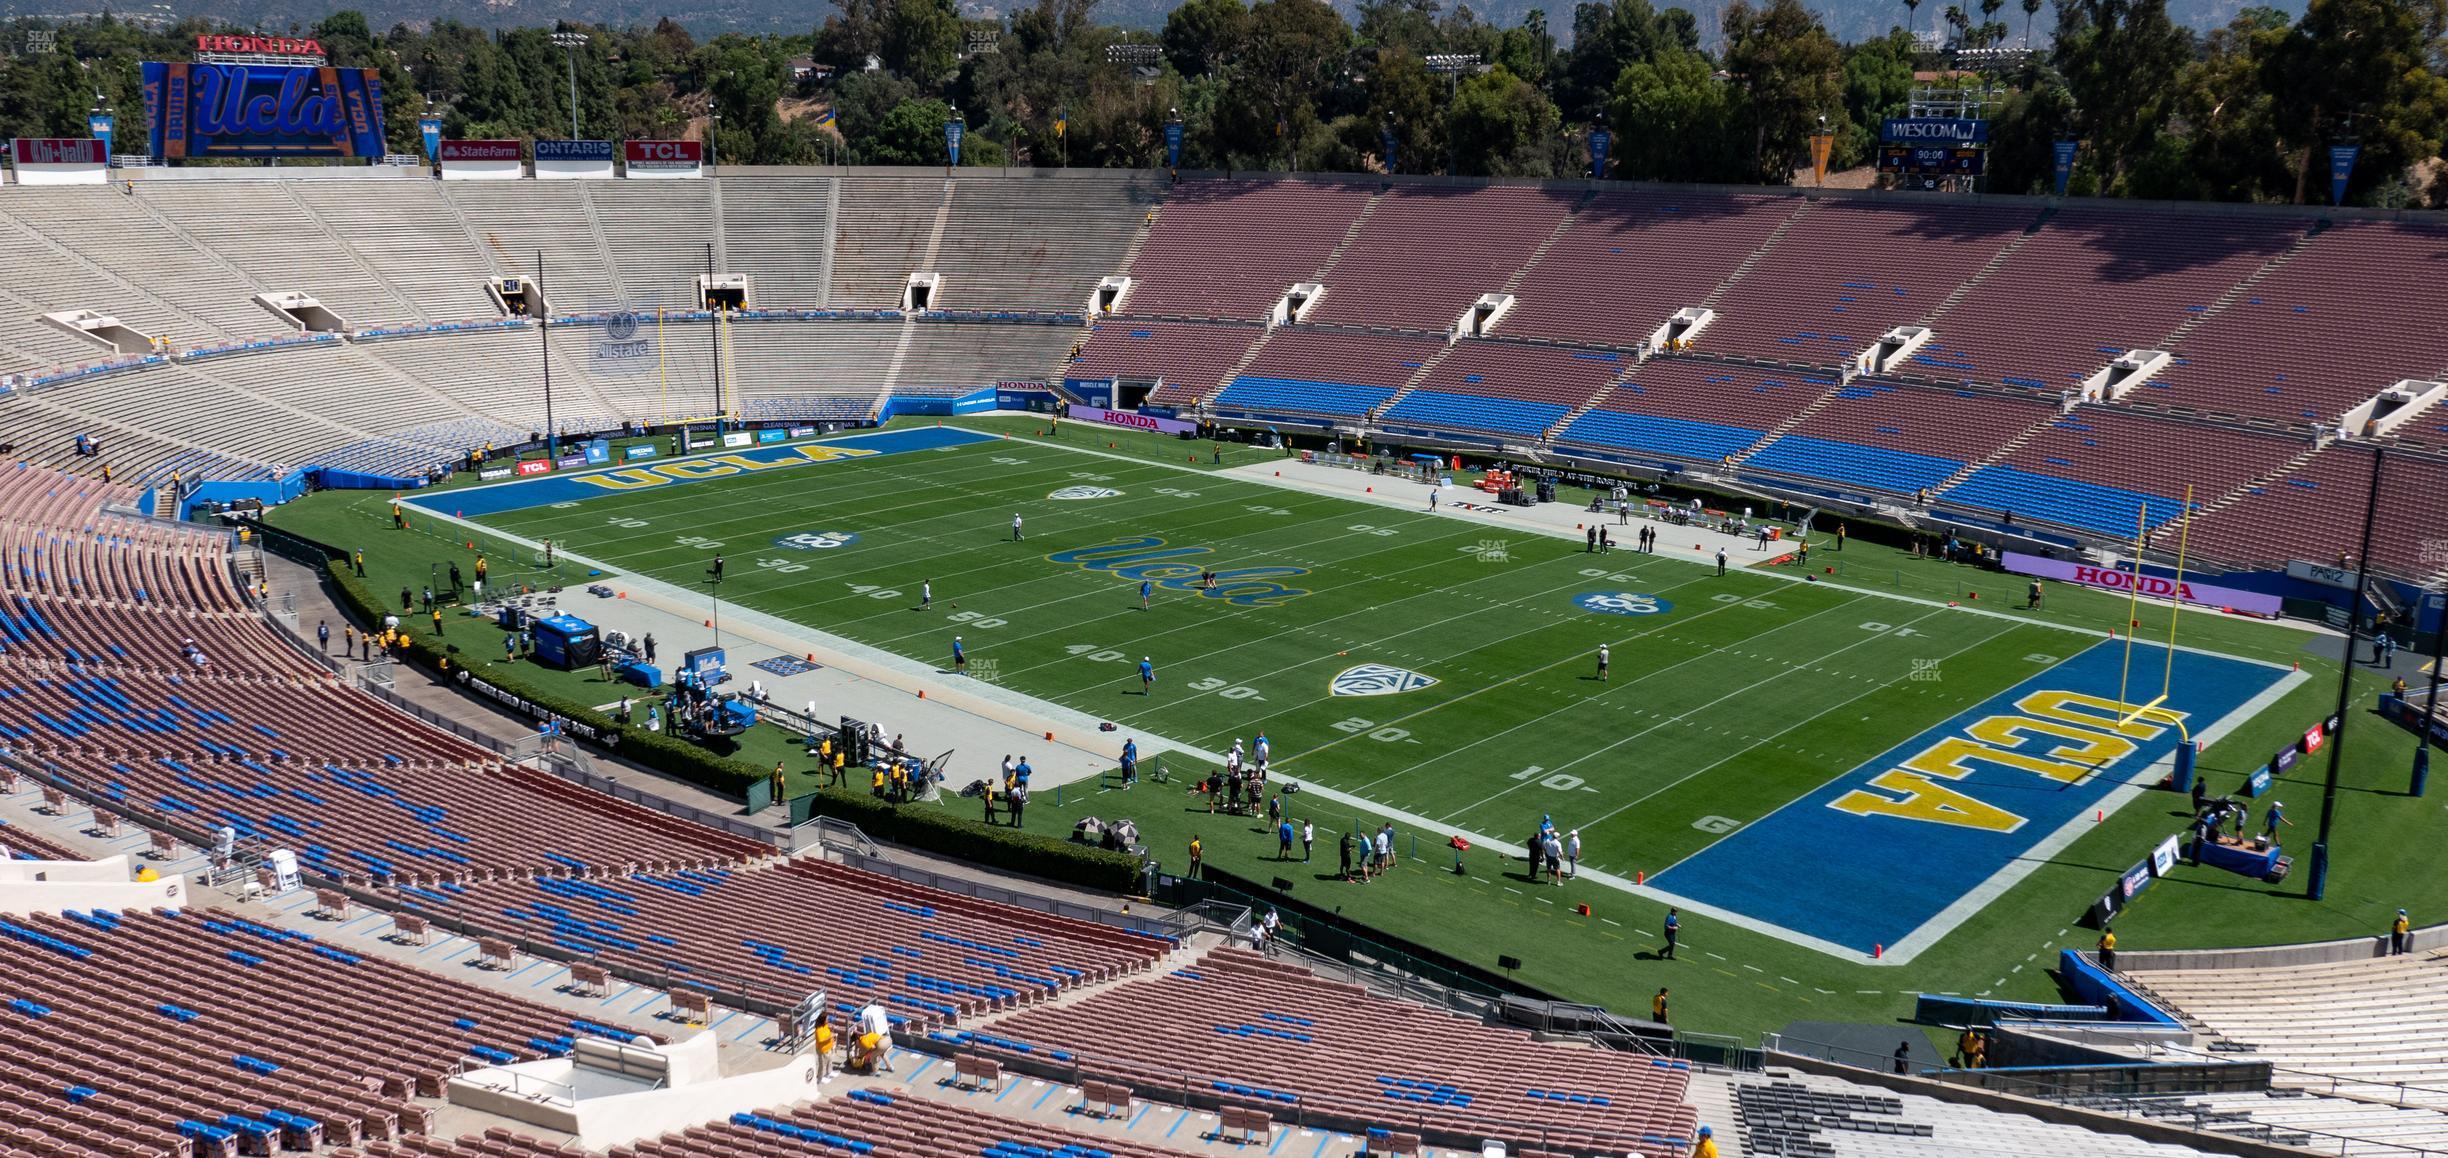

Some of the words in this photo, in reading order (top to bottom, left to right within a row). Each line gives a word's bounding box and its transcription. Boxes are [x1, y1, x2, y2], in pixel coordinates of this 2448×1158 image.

[197, 34, 327, 56] HONDA
[169, 77, 185, 141] BRUINS
[193, 66, 346, 136] Ucla
[348, 89, 369, 134] UCLA
[1891, 123, 1957, 138] WESCOM
[537, 142, 611, 154] ONTARIO
[640, 143, 688, 159] TCL
[1918, 150, 1943, 159] 90:00
[1893, 157, 1899, 165] 0
[1962, 159, 1968, 168] 0
[504, 280, 519, 291] 40
[598, 341, 648, 357] Allstate
[998, 381, 1046, 390] HONDA
[1103, 411, 1160, 429] HONDA
[481, 468, 511, 478] NISSAN
[523, 462, 547, 473] TCL
[569, 445, 882, 490] UCLA
[784, 533, 842, 548] 100
[757, 558, 811, 574] 30
[1044, 535, 1313, 608] Ucla
[2074, 566, 2196, 600] HONDA
[1584, 594, 1660, 614] 100
[946, 611, 1009, 629] 50
[1065, 644, 1126, 662] 40
[1187, 677, 1260, 700] 30
[498, 689, 519, 708] FIELD
[520, 700, 531, 713] AT
[531, 704, 549, 720] THE
[571, 720, 598, 740] BOWL
[1329, 716, 1411, 742] 20
[2306, 730, 2321, 748] TCL
[1825, 690, 2191, 834] UCLA
[1508, 765, 1585, 791] 10
[1691, 815, 1742, 834] G
